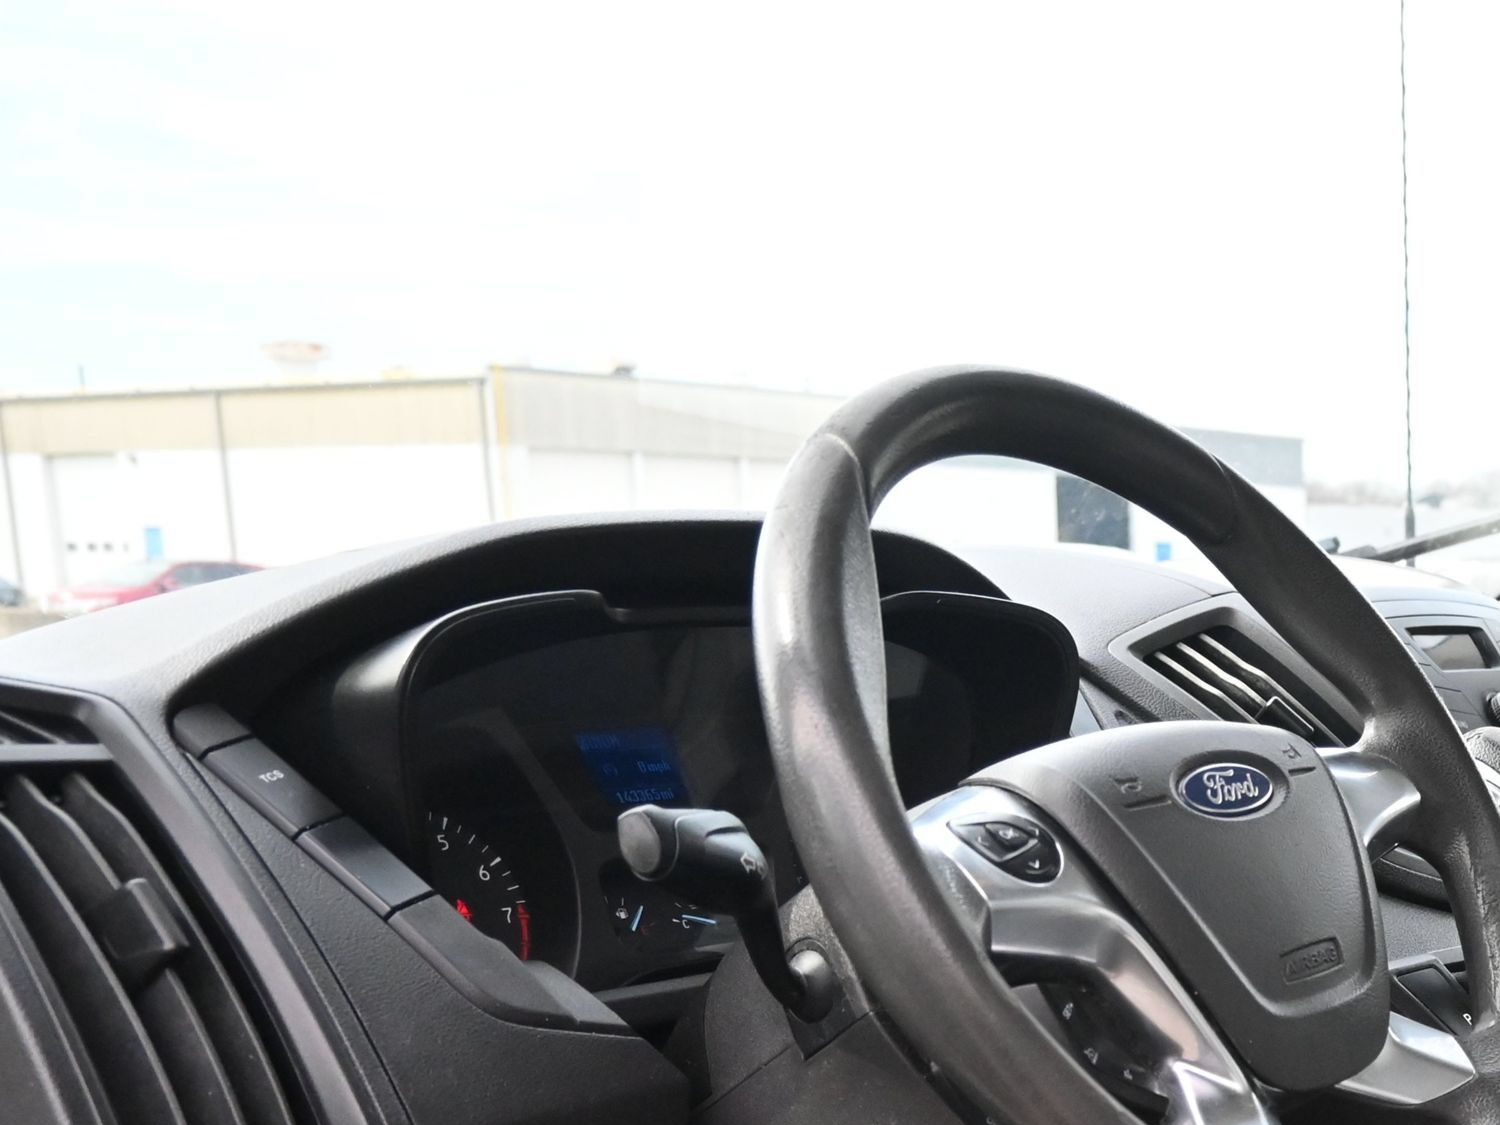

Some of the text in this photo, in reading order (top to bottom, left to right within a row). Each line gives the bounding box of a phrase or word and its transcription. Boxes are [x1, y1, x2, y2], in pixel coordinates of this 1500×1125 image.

[259, 770, 284, 783] TCS
[1203, 769, 1259, 804] Ford
[436, 834, 450, 851] 5
[479, 865, 491, 882] 6
[501, 907, 512, 923] 7
[1286, 946, 1337, 975] ARBAG
